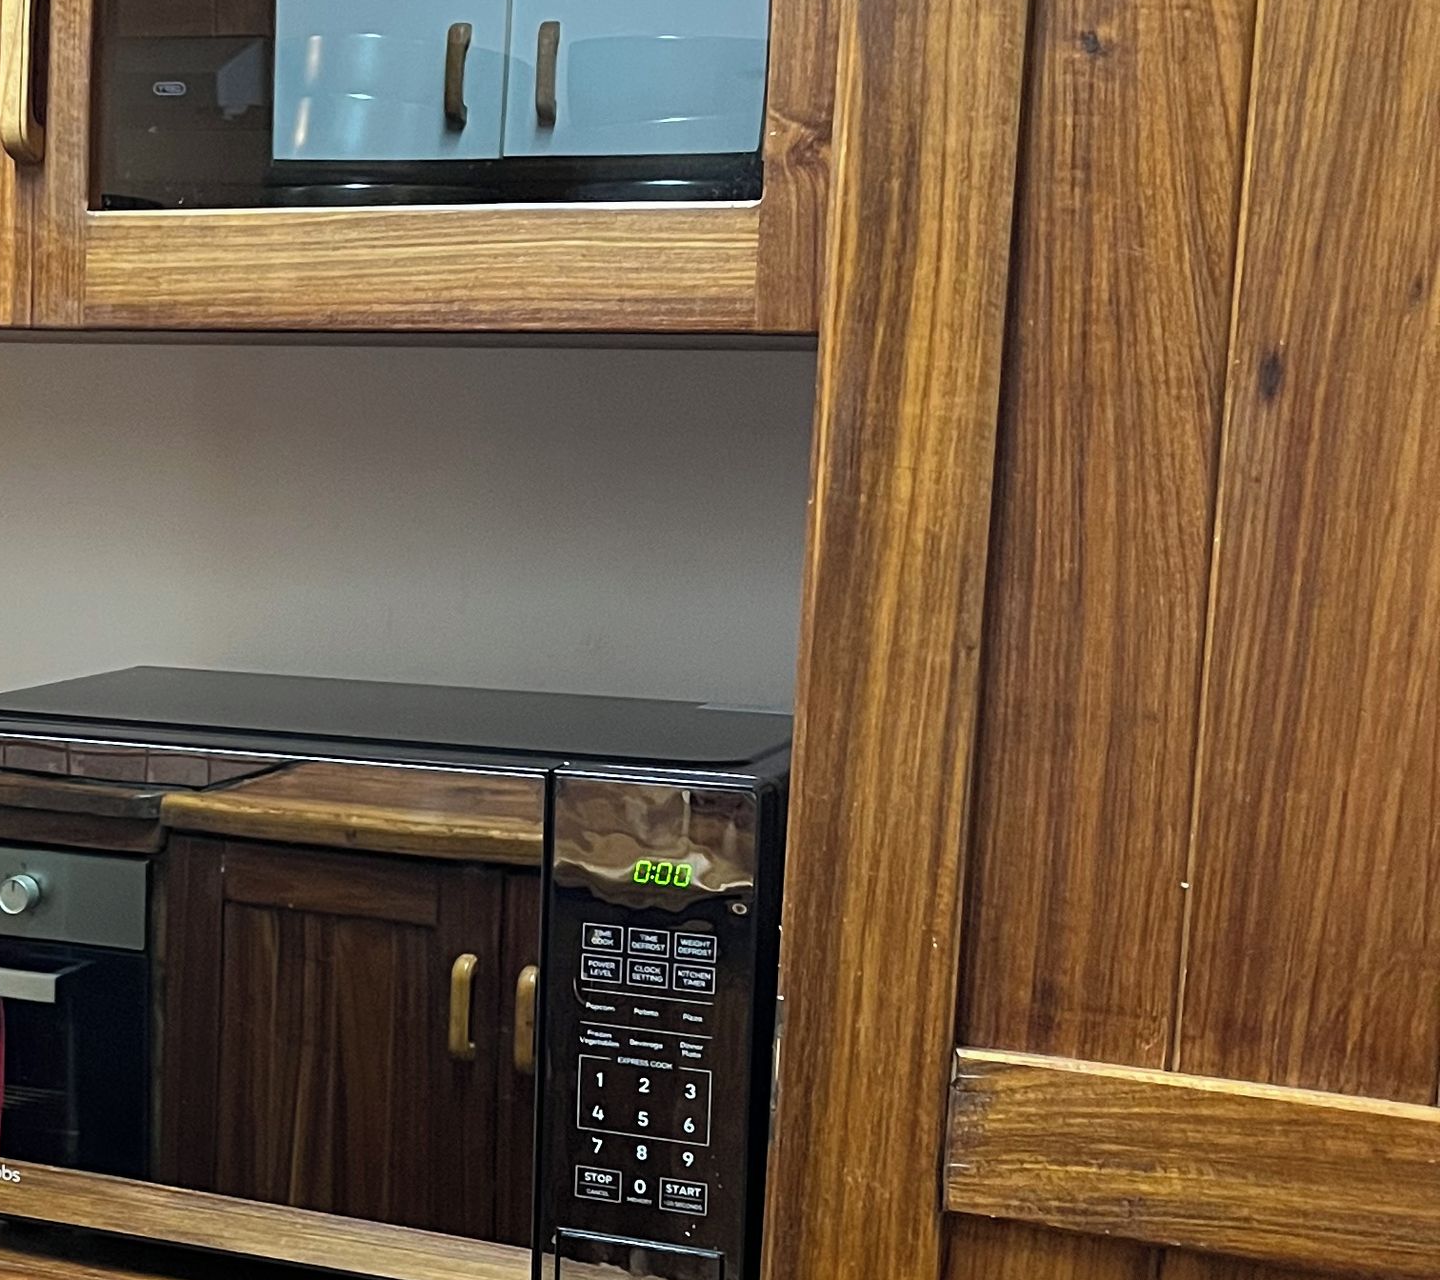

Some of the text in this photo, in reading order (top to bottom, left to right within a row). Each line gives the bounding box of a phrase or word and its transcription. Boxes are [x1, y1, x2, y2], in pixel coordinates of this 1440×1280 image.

[633, 859, 692, 887] 0:00
[639, 933, 658, 943] TIME
[680, 938, 711, 949] WEIGHT
[631, 941, 665, 952] DEFROST
[677, 946, 712, 957] DEFROST
[588, 960, 616, 970] POWER
[633, 965, 661, 975] CLOCK
[590, 968, 613, 978] LEVEL
[631, 972, 664, 983] SETTING
[677, 970, 712, 980] KITCHEN
[617, 1056, 673, 1070] EXPRESS COOK
[596, 1072, 696, 1100] 1 2 3
[592, 1105, 695, 1133] 4 5 6
[591, 1136, 694, 1167] 7 8 9
[584, 1171, 613, 1184] STOP
[634, 1179, 646, 1194] 0
[665, 1184, 702, 1198] START
